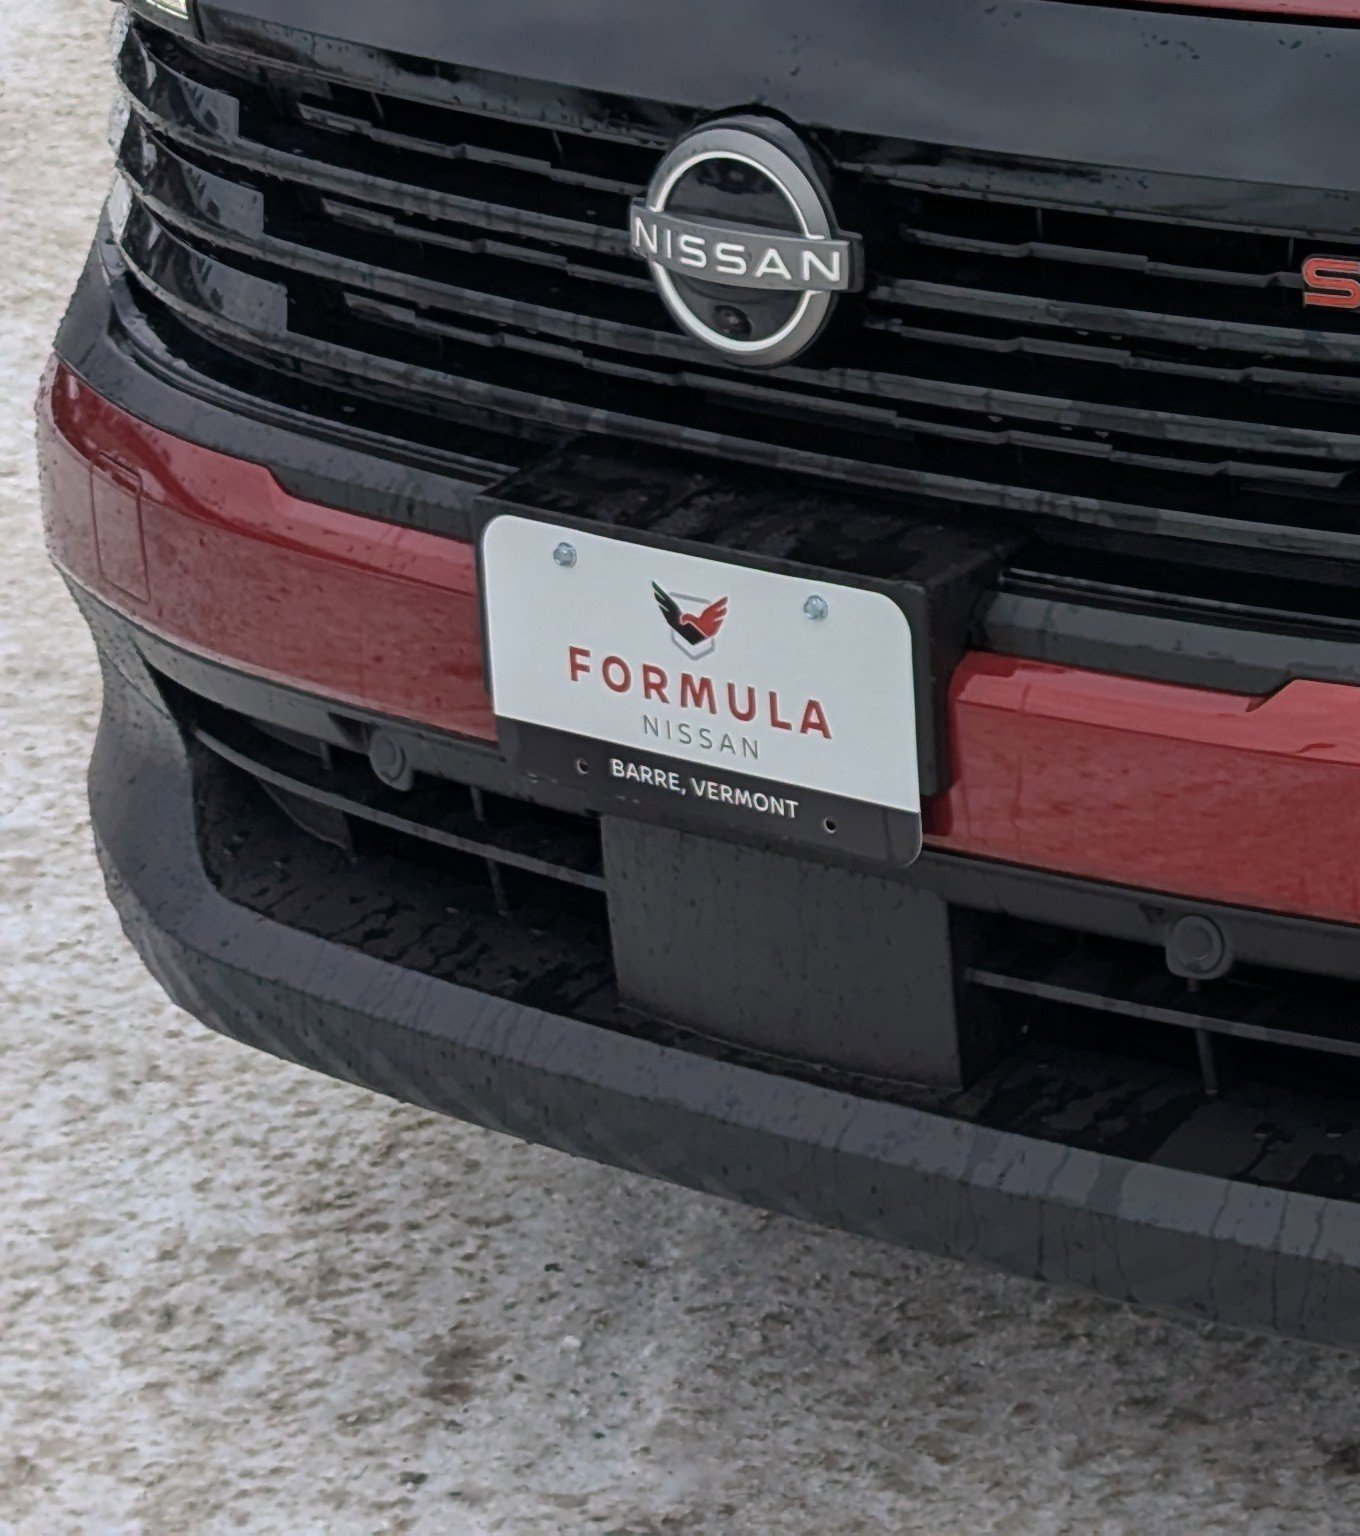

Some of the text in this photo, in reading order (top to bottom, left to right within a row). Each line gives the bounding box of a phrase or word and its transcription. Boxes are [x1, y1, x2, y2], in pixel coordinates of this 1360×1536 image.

[632, 216, 841, 282] NISSAN
[568, 645, 832, 740] FORMULA
[642, 714, 760, 760] NISSAN
[610, 757, 799, 819] BARRE, VERMONT
